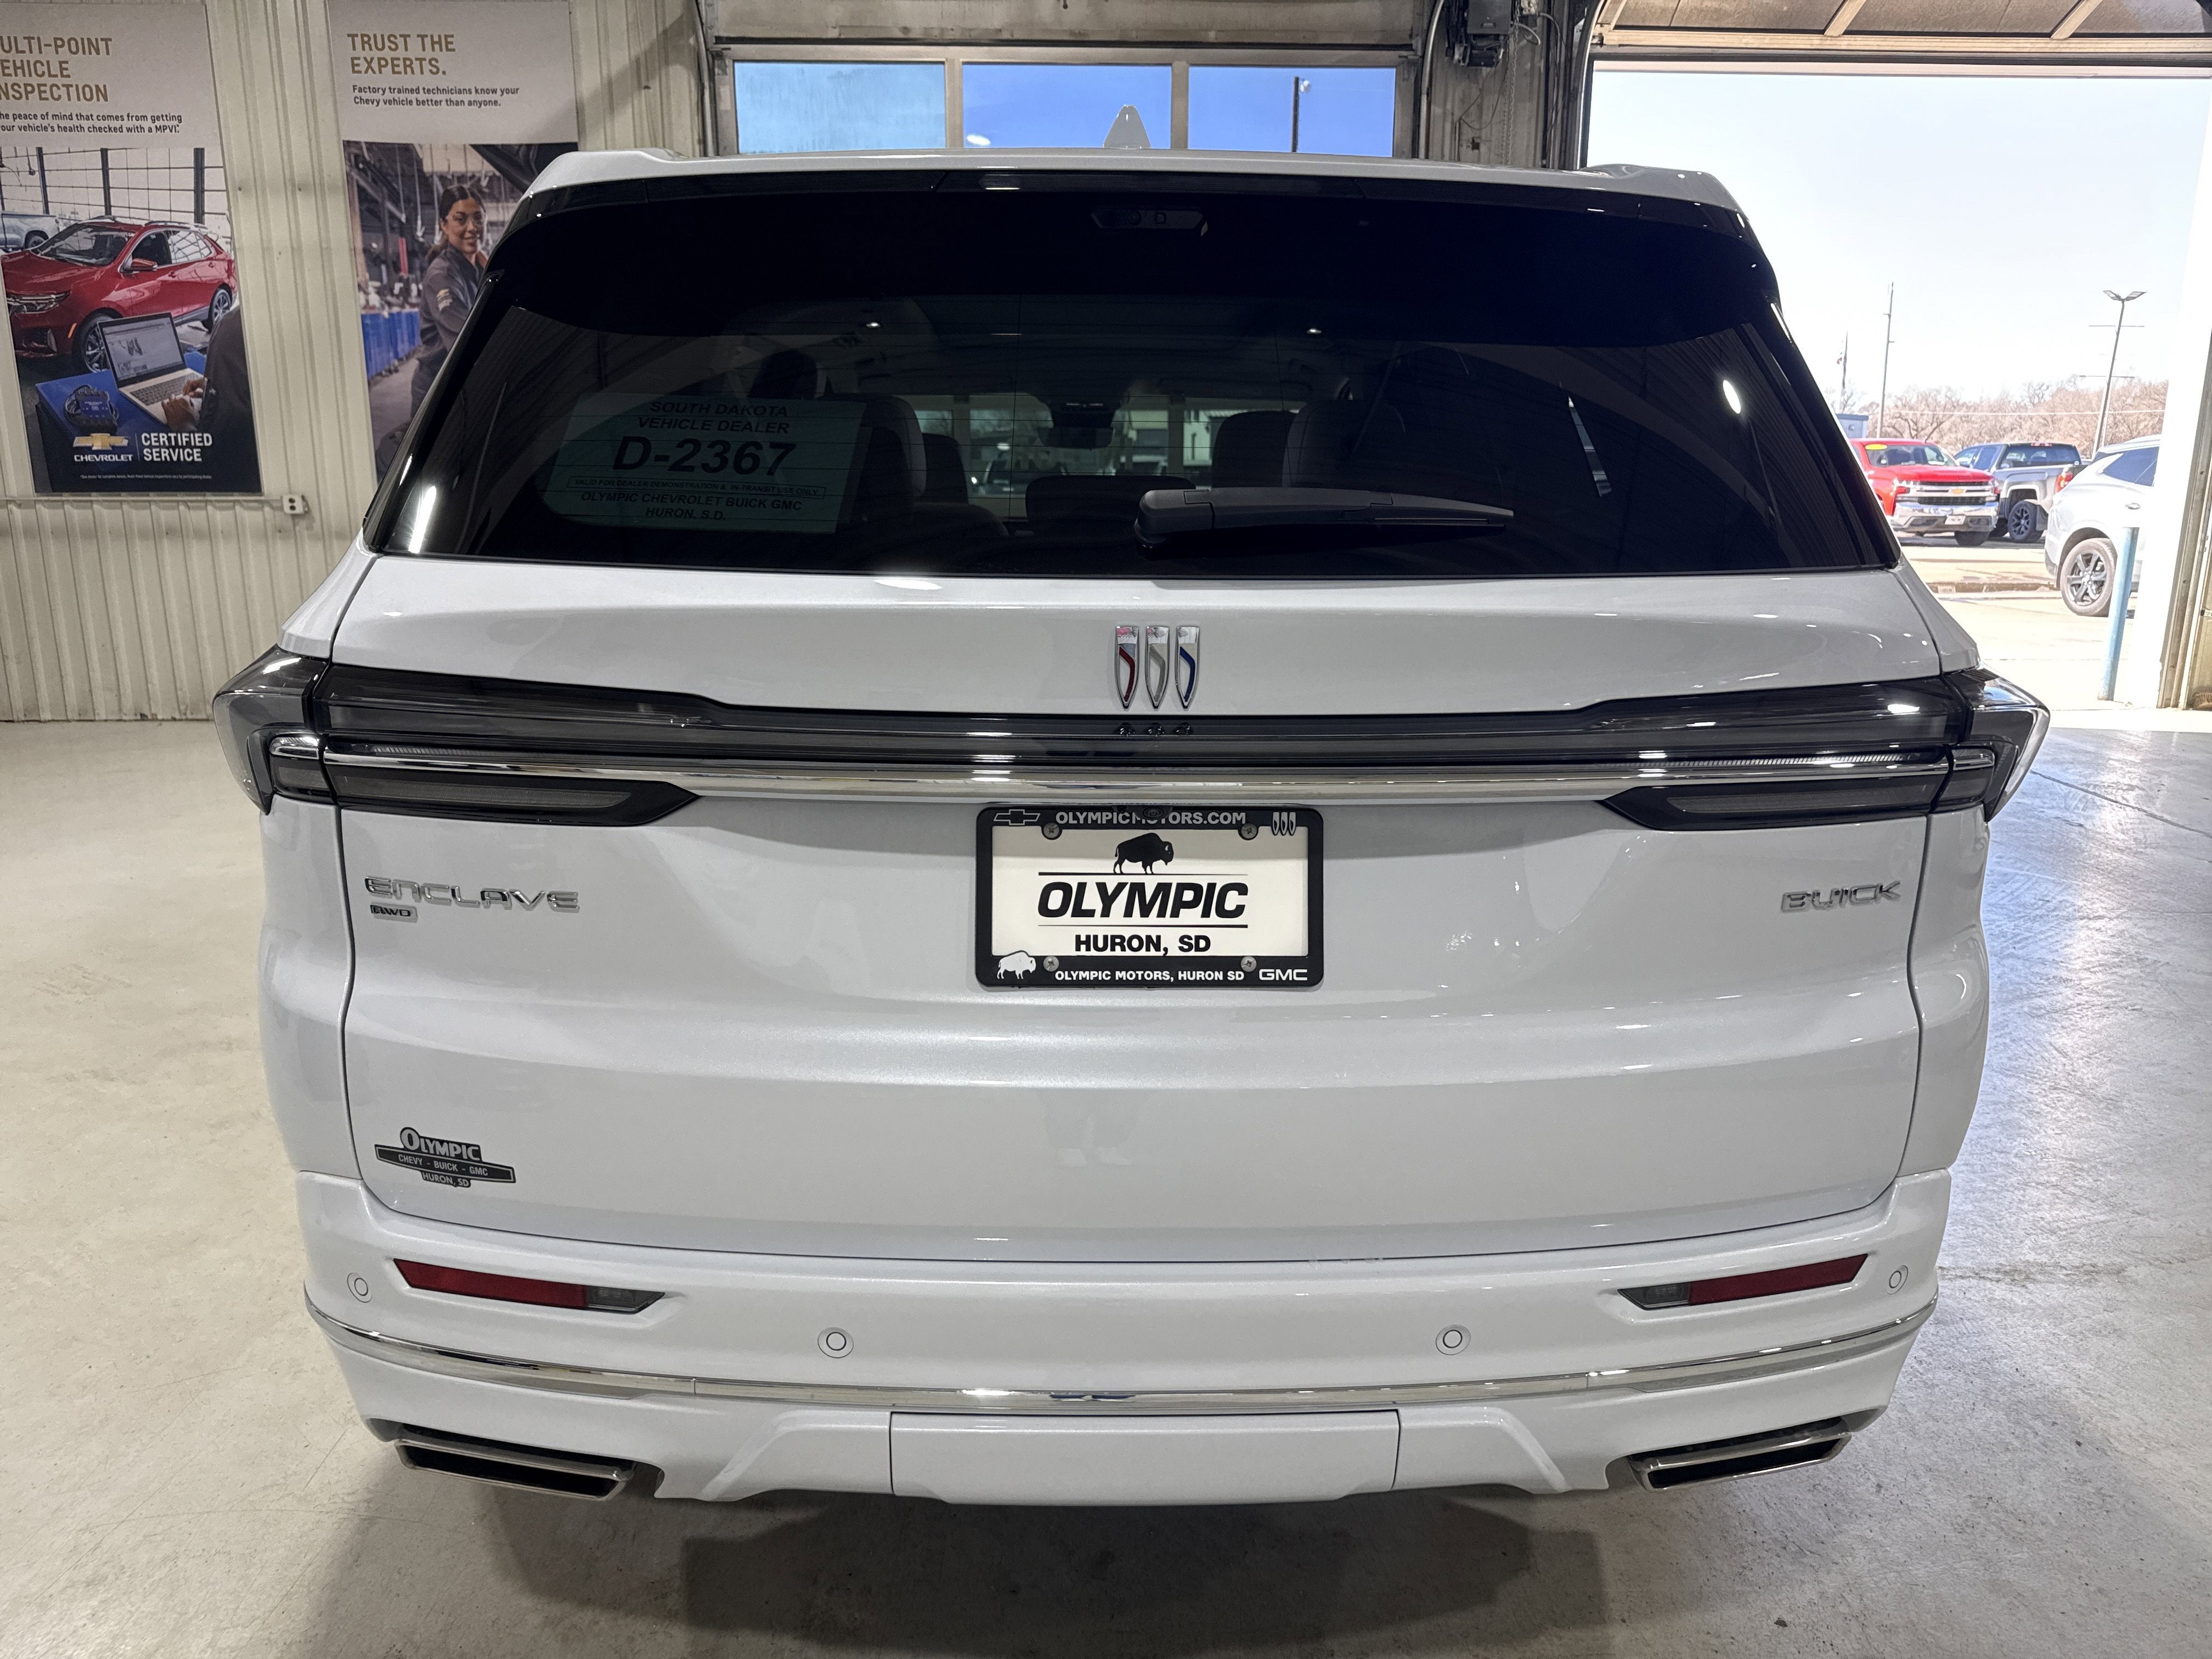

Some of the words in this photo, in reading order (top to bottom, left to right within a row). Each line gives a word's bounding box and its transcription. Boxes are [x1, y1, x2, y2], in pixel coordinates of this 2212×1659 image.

[0, 35, 112, 56] ULTI-POINT
[347, 33, 411, 52] TRUST
[416, 33, 456, 53] THE
[0, 59, 71, 78] EHICLE
[350, 56, 447, 76] EXPERTS.
[0, 82, 109, 103] NSPECTION
[352, 84, 387, 95] Factory
[388, 85, 420, 95] trained
[422, 86, 473, 95] technicians
[474, 86, 498, 95] know
[500, 87, 520, 97] your
[353, 96, 381, 108] Chevy
[382, 97, 414, 106] vehicle
[415, 98, 443, 107] better
[445, 98, 466, 107] than
[467, 99, 501, 109] anyone.
[0, 111, 10, 120] he
[12, 112, 38, 122] peace
[40, 111, 50, 120] of
[52, 111, 74, 121] mind
[76, 112, 94, 121] that
[127, 112, 148, 122] from
[150, 112, 183, 124] getting
[18, 123, 55, 133] vehicle's
[57, 123, 86, 133] health
[87, 124, 124, 134] checked
[126, 124, 145, 133] with
[650, 400, 711, 414] SOUTH
[714, 403, 788, 418] DAKOTA
[638, 416, 713, 431] VEHICLE
[717, 420, 790, 434] DEALER
[141, 432, 213, 447] CERTIFIED
[74, 454, 133, 462] CHEVROLET
[143, 448, 202, 462] SERVICE
[612, 435, 797, 476] D-2367
[651, 481, 719, 490] DEMONSTRATION
[581, 492, 638, 503] OLYMPIC
[641, 493, 723, 506] CHEVROLET
[725, 497, 769, 509] BUICK
[771, 499, 803, 511] GMC
[364, 876, 580, 913] ENCLAVE
[1037, 881, 1249, 918] OLYMPIC
[1781, 881, 1901, 913] BUICK
[1074, 934, 1169, 956] HURON,
[1177, 934, 1211, 952] SD
[1054, 970, 1111, 981] OLYMPIC
[1115, 970, 1174, 982] MOTORS,
[1178, 970, 1223, 981] HURON
[1227, 970, 1245, 981] SD
[1259, 969, 1308, 981] GMC
[400, 1128, 481, 1161] OLYMPIC
[398, 1153, 422, 1166] CHEVY
[434, 1160, 459, 1172] BUICK
[469, 1166, 488, 1176] GMC
[422, 1172, 456, 1186] HURON,
[458, 1177, 470, 1187] SD
